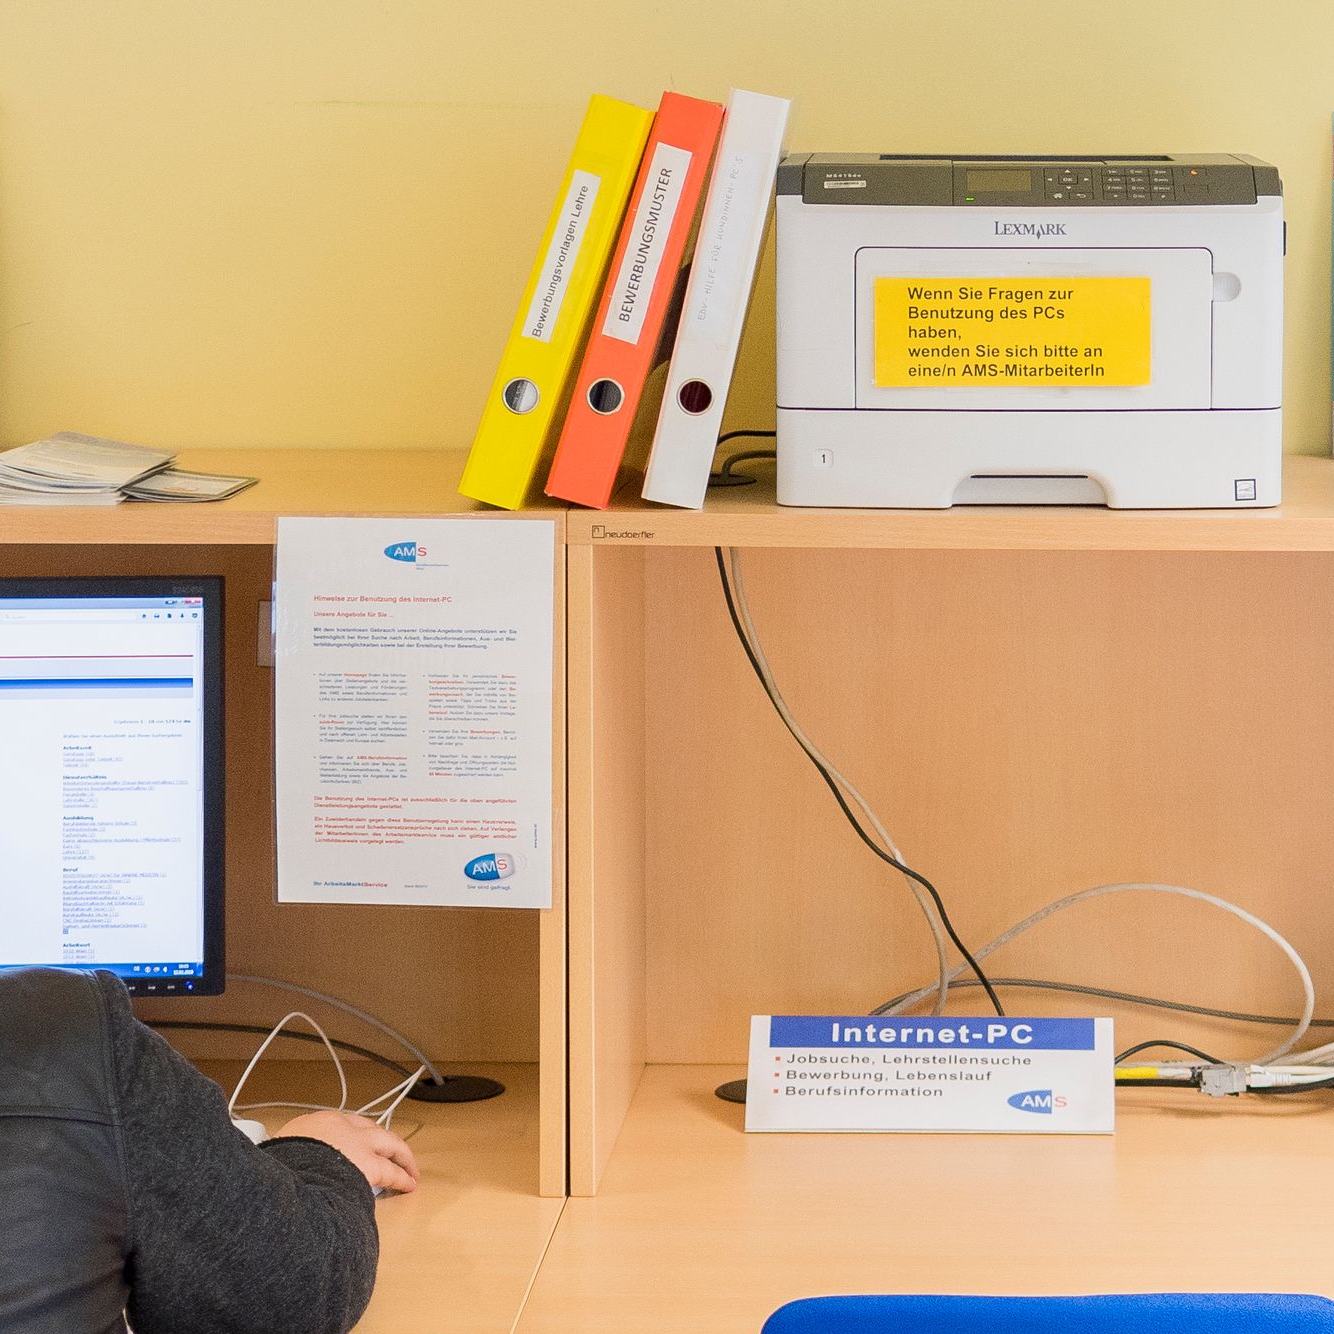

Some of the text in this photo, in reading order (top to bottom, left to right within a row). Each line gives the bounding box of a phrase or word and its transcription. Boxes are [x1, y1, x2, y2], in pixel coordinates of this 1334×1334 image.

[994, 220, 1067, 239] LEXMARK
[618, 167, 673, 323] BEWERBUNGSMUSTER
[532, 184, 589, 338] Bewerbungsvorlagen Lehre
[907, 286, 1074, 303] Wenn Sie Fragen zur
[909, 305, 1065, 322] Benutzung des PCs
[909, 326, 961, 341] haben,
[907, 344, 1103, 358] wenden Sie sich bitte an
[908, 363, 1105, 377] eine/n AMS-MitarbeiterIn
[604, 528, 655, 540] neudoerfler
[393, 546, 427, 557] AMS
[359, 595, 398, 604] Benutzung
[398, 595, 412, 603] des
[411, 595, 452, 603] Internet-PC
[472, 859, 508, 876] AMS
[833, 1023, 1033, 1044] Internet-PC
[787, 1054, 1031, 1065] Jobsuche, Lehrstellensuche
[787, 1070, 991, 1082] Bewerbung, Lebenslauf
[786, 1086, 942, 1096] Berufsinformation
[1020, 1095, 1067, 1108] AMS
